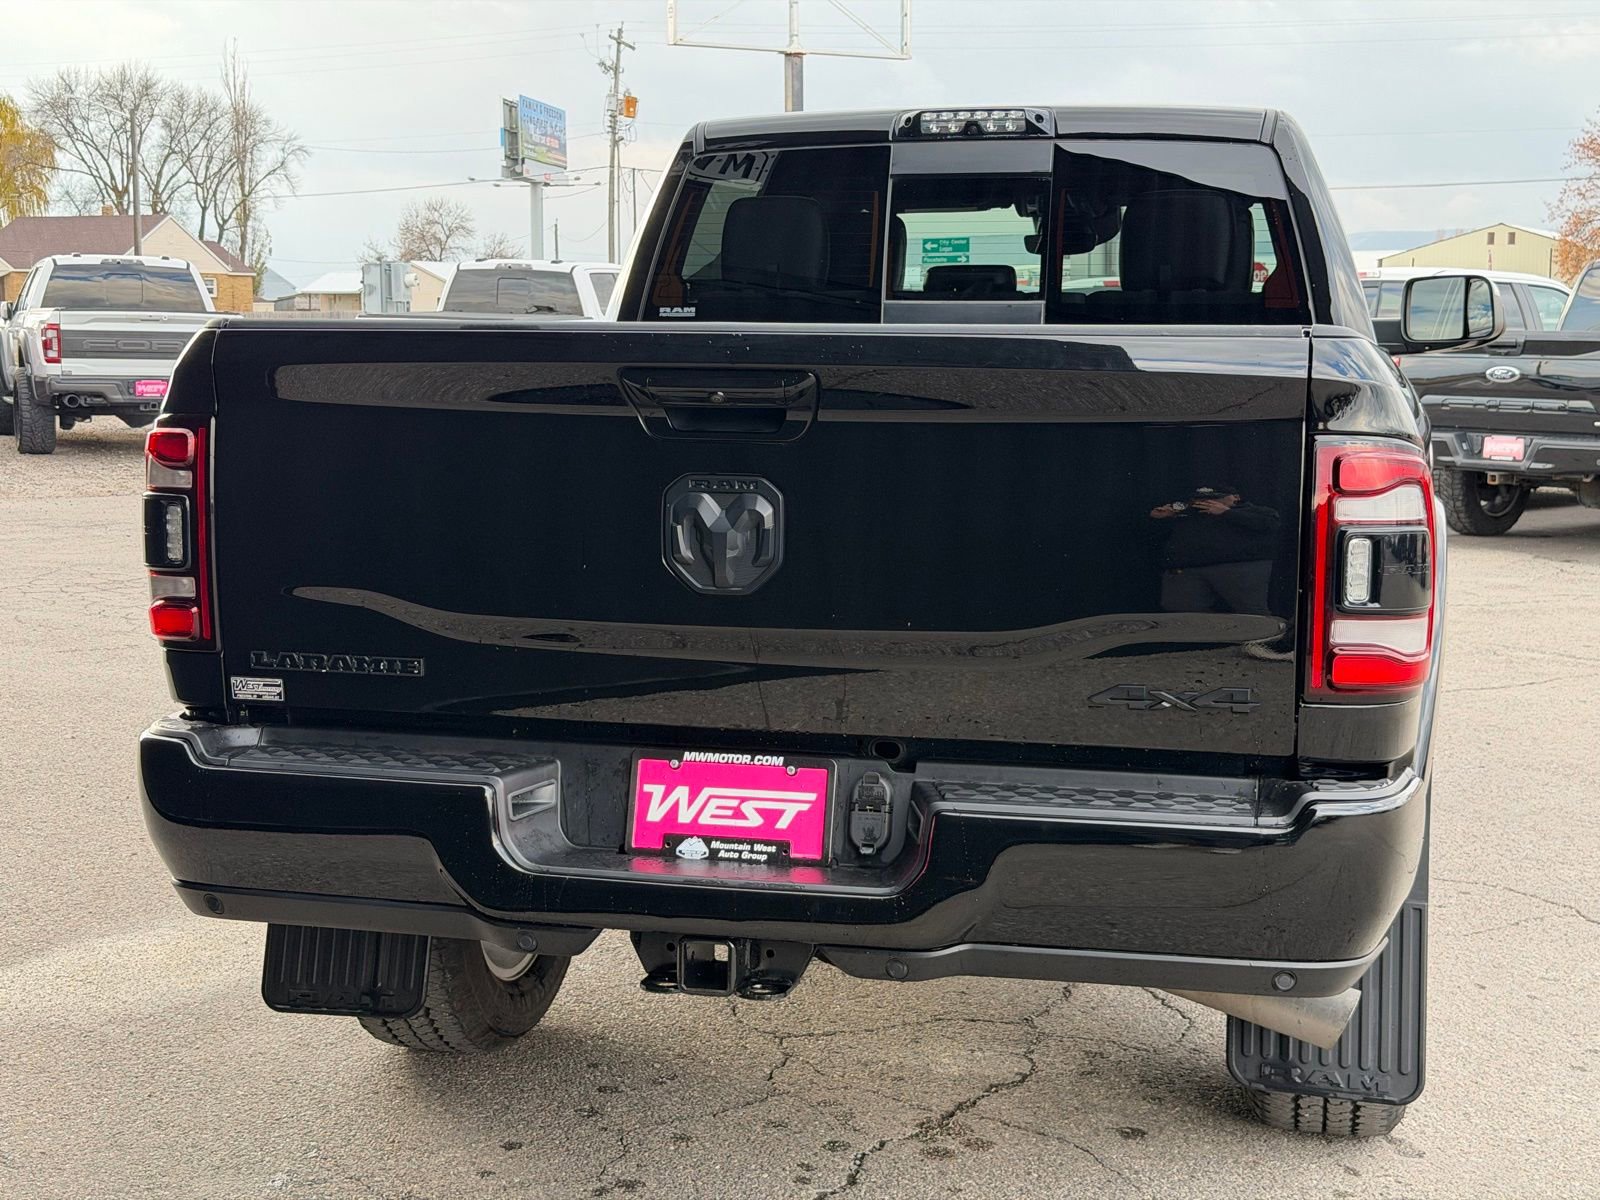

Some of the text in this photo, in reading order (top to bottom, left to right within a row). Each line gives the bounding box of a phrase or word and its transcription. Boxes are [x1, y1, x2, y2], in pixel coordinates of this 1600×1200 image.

[1253, 270, 1268, 282] OP
[82, 339, 187, 351] FOR
[688, 479, 760, 490] RAM
[250, 650, 425, 677] LARAMIE
[683, 751, 785, 767] MWMOTOR.COM
[643, 783, 818, 830] WEST
[710, 840, 777, 853] Mountain West
[718, 850, 768, 862] Auto Group
[1260, 1062, 1393, 1097] RAM
